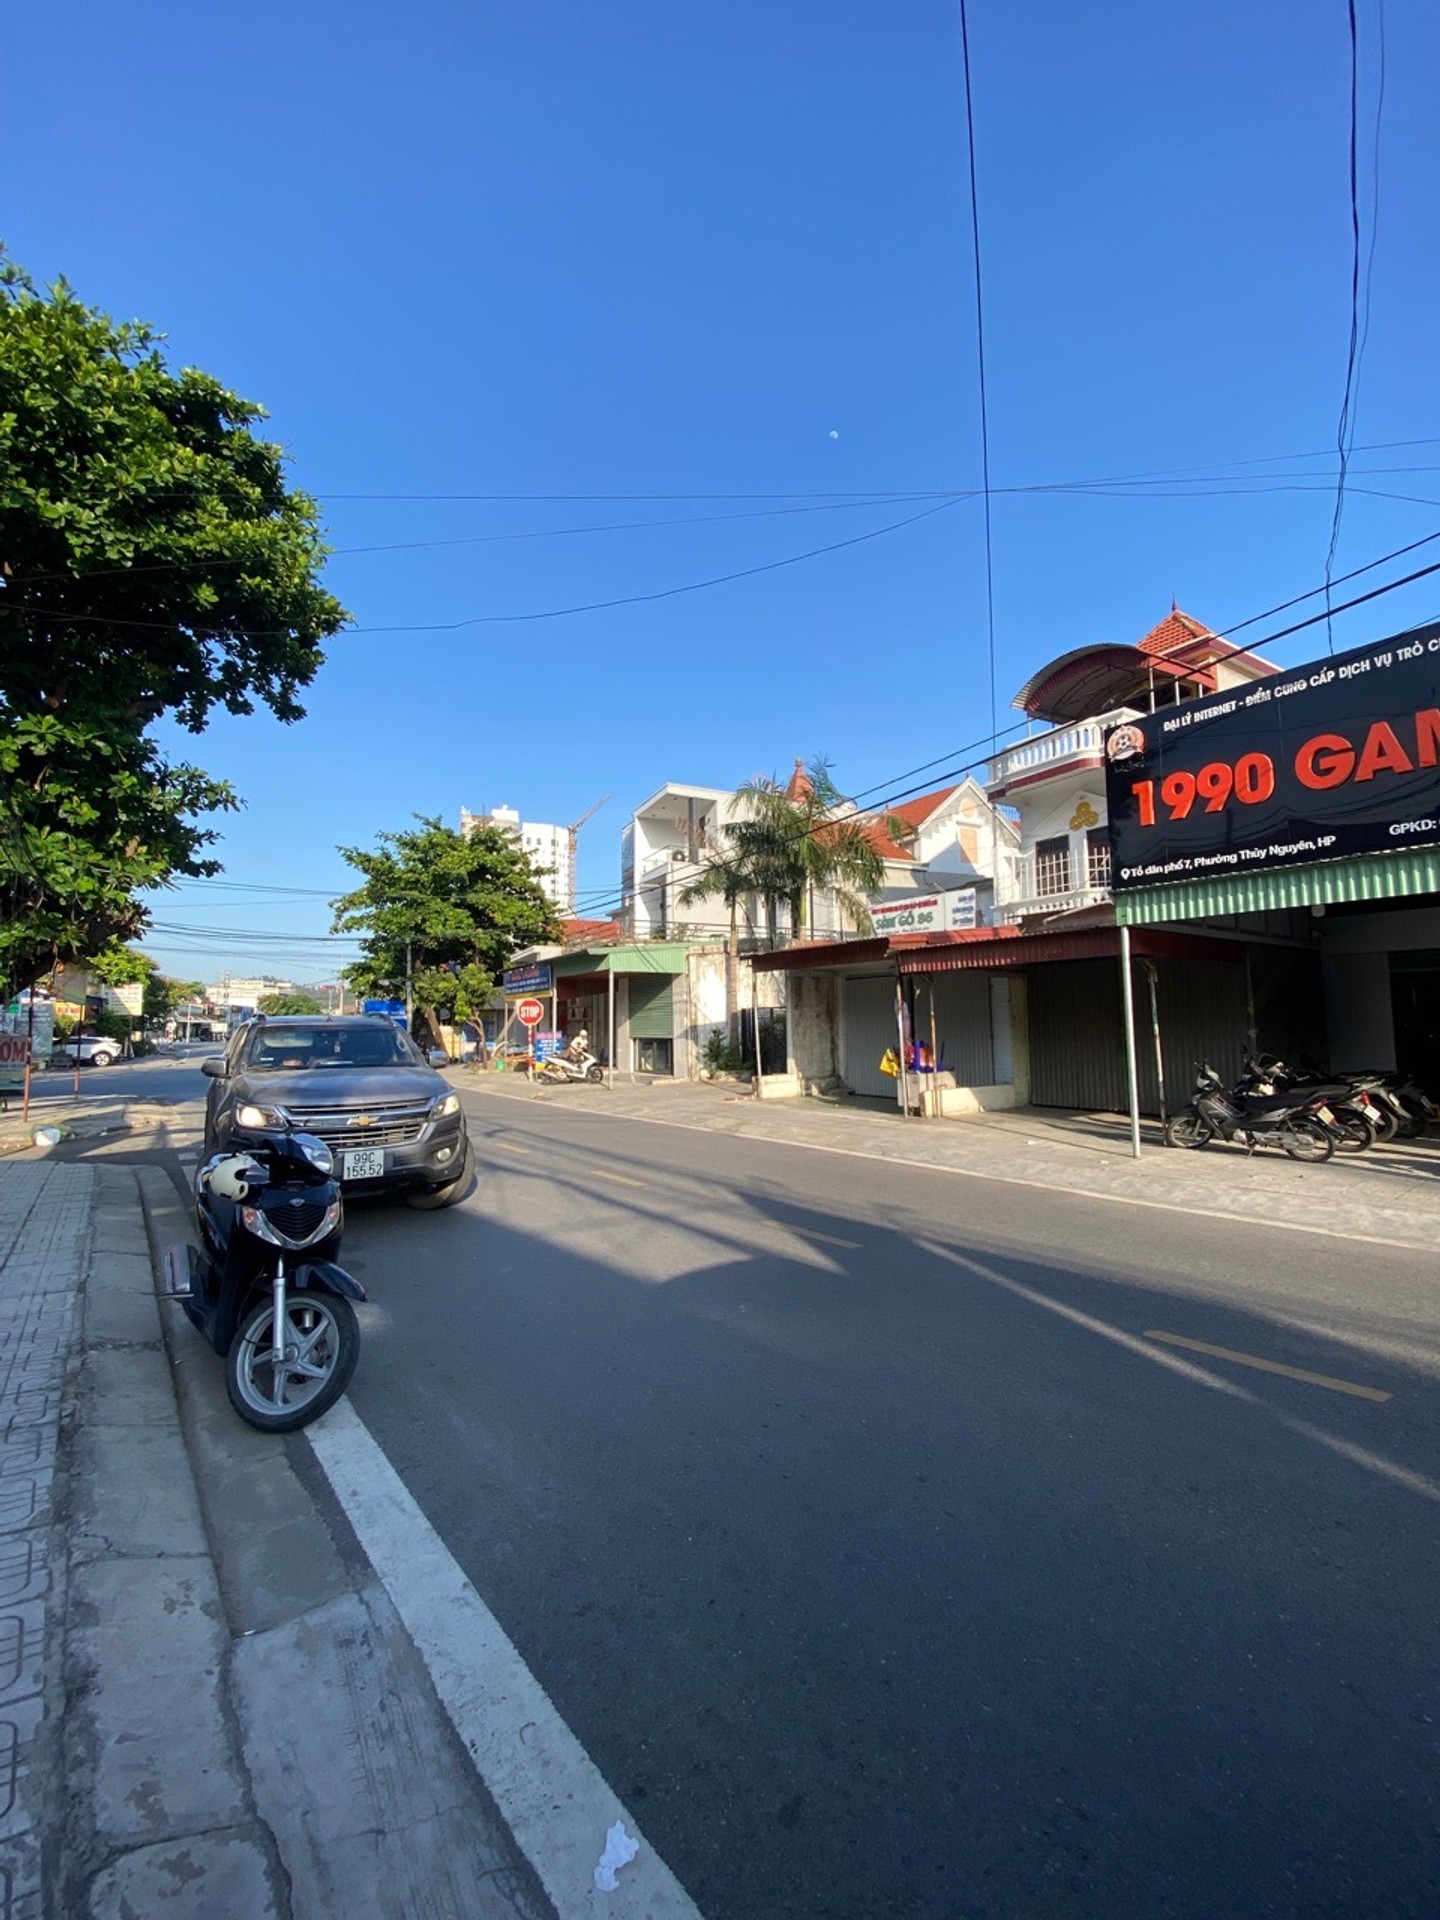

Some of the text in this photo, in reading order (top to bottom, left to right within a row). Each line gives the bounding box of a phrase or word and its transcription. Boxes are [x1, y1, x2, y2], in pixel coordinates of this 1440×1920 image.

[1163, 718, 1180, 732] ĐẠI
[1181, 711, 1192, 726] LÝ
[1194, 700, 1237, 722] INTERNET
[1245, 687, 1271, 707] ĐIỂM
[1274, 679, 1307, 698] CUNG
[1309, 666, 1335, 687] CẤP
[1339, 660, 1370, 680] DỊCH
[1374, 652, 1392, 668] VỤ
[1396, 640, 1424, 662] TRÒ
[1427, 638, 1440, 653] C
[1132, 752, 1275, 827] 1990
[1389, 819, 1437, 836] GPKD:
[1144, 863, 1163, 875] dân
[1164, 858, 1184, 874] phố
[1183, 859, 1193, 871] 7,
[1193, 854, 1238, 867] Phường
[1269, 839, 1316, 858] Nguyên,
[1316, 835, 1337, 848] HP
[917, 911, 933, 925] 86
[520, 1006, 540, 1019] STOP
[353, 1151, 375, 1165] 99C
[346, 1163, 383, 1179] 155.52
